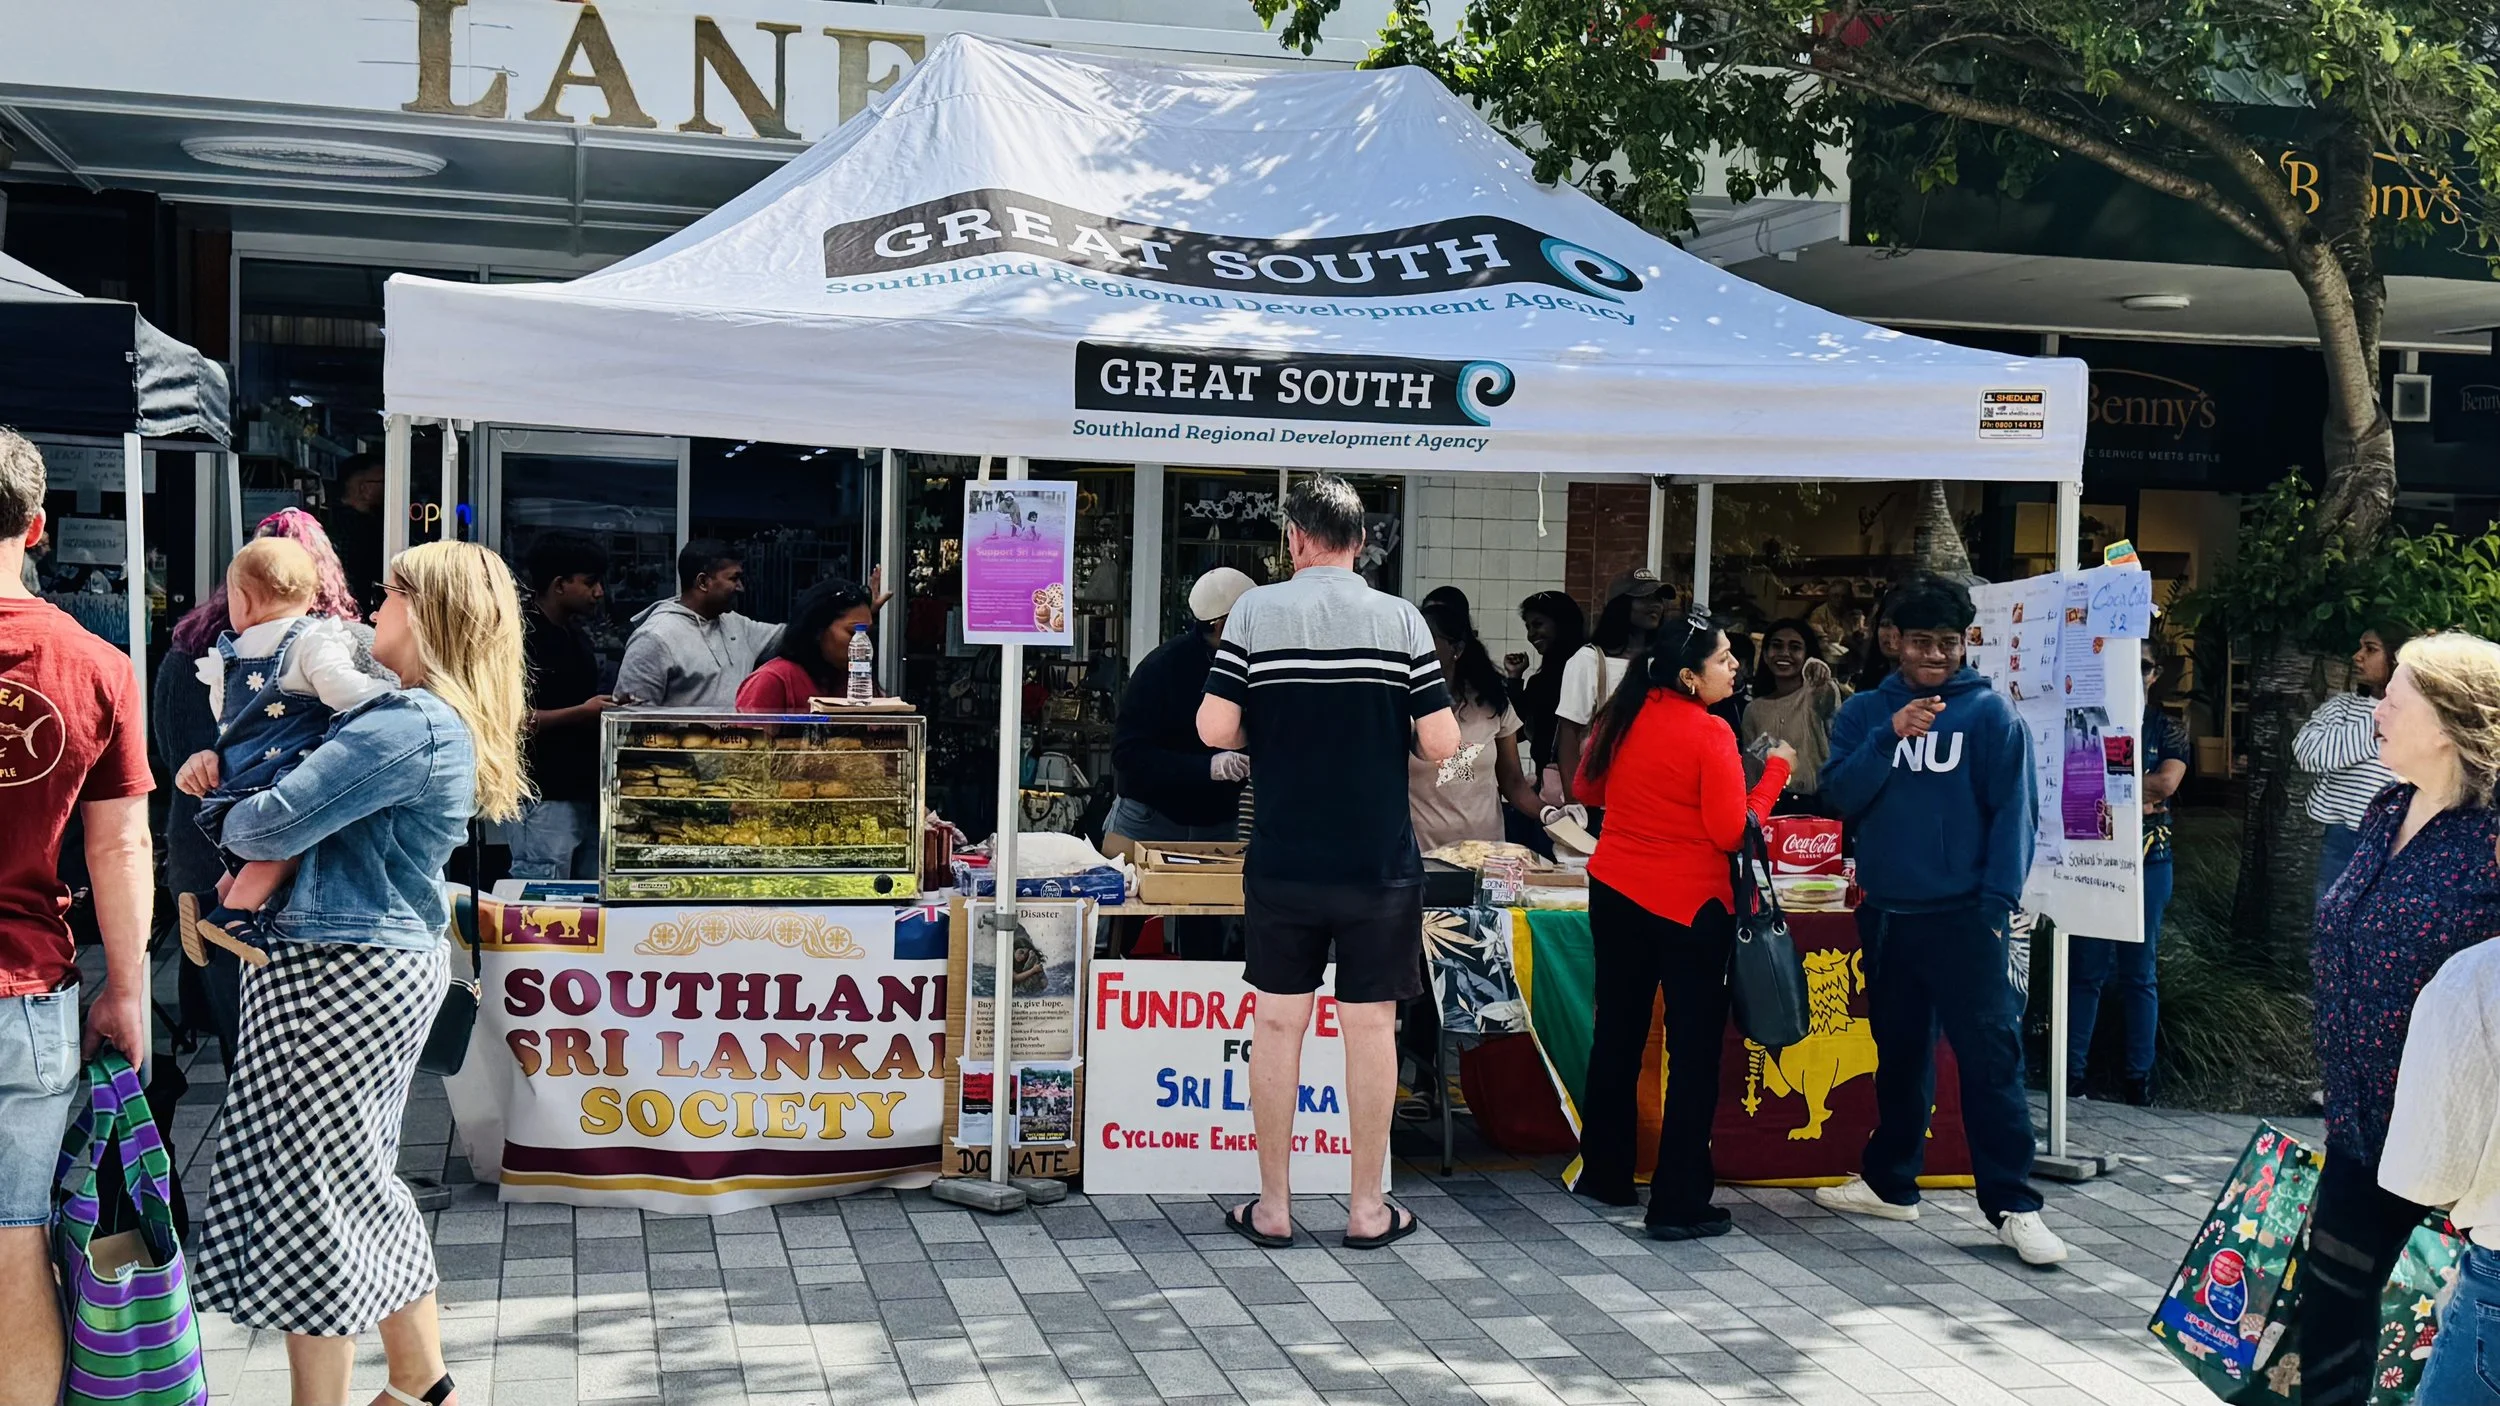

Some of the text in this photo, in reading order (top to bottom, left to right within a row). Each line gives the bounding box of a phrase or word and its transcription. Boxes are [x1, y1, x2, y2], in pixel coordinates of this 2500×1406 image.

[874, 206, 1511, 284] GREAT SOUTH
[826, 260, 1636, 326] Southland Regional Development Agency
[1100, 358, 1434, 409] GREAT SOUTH
[1996, 394, 2040, 402] SHEDLINE
[1073, 420, 1490, 452] Southland Regional Development Agency
[2098, 450, 2144, 460] SERVICE
[2149, 451, 2184, 461] MEETS
[2188, 453, 2221, 463] STYLE
[409, 502, 472, 533] opn
[1782, 833, 1840, 854] Coca-Cola
[1020, 909, 1059, 919] Disaster
[977, 1000, 992, 1009] Buy
[1023, 1001, 1040, 1009] give
[1041, 999, 1064, 1009] hope.
[505, 1027, 631, 1078] SRI
[1156, 1067, 1340, 1113] SRI LKA
[580, 1086, 906, 1139] SOCIETY
[1102, 1122, 1199, 1150] CYCLONE
